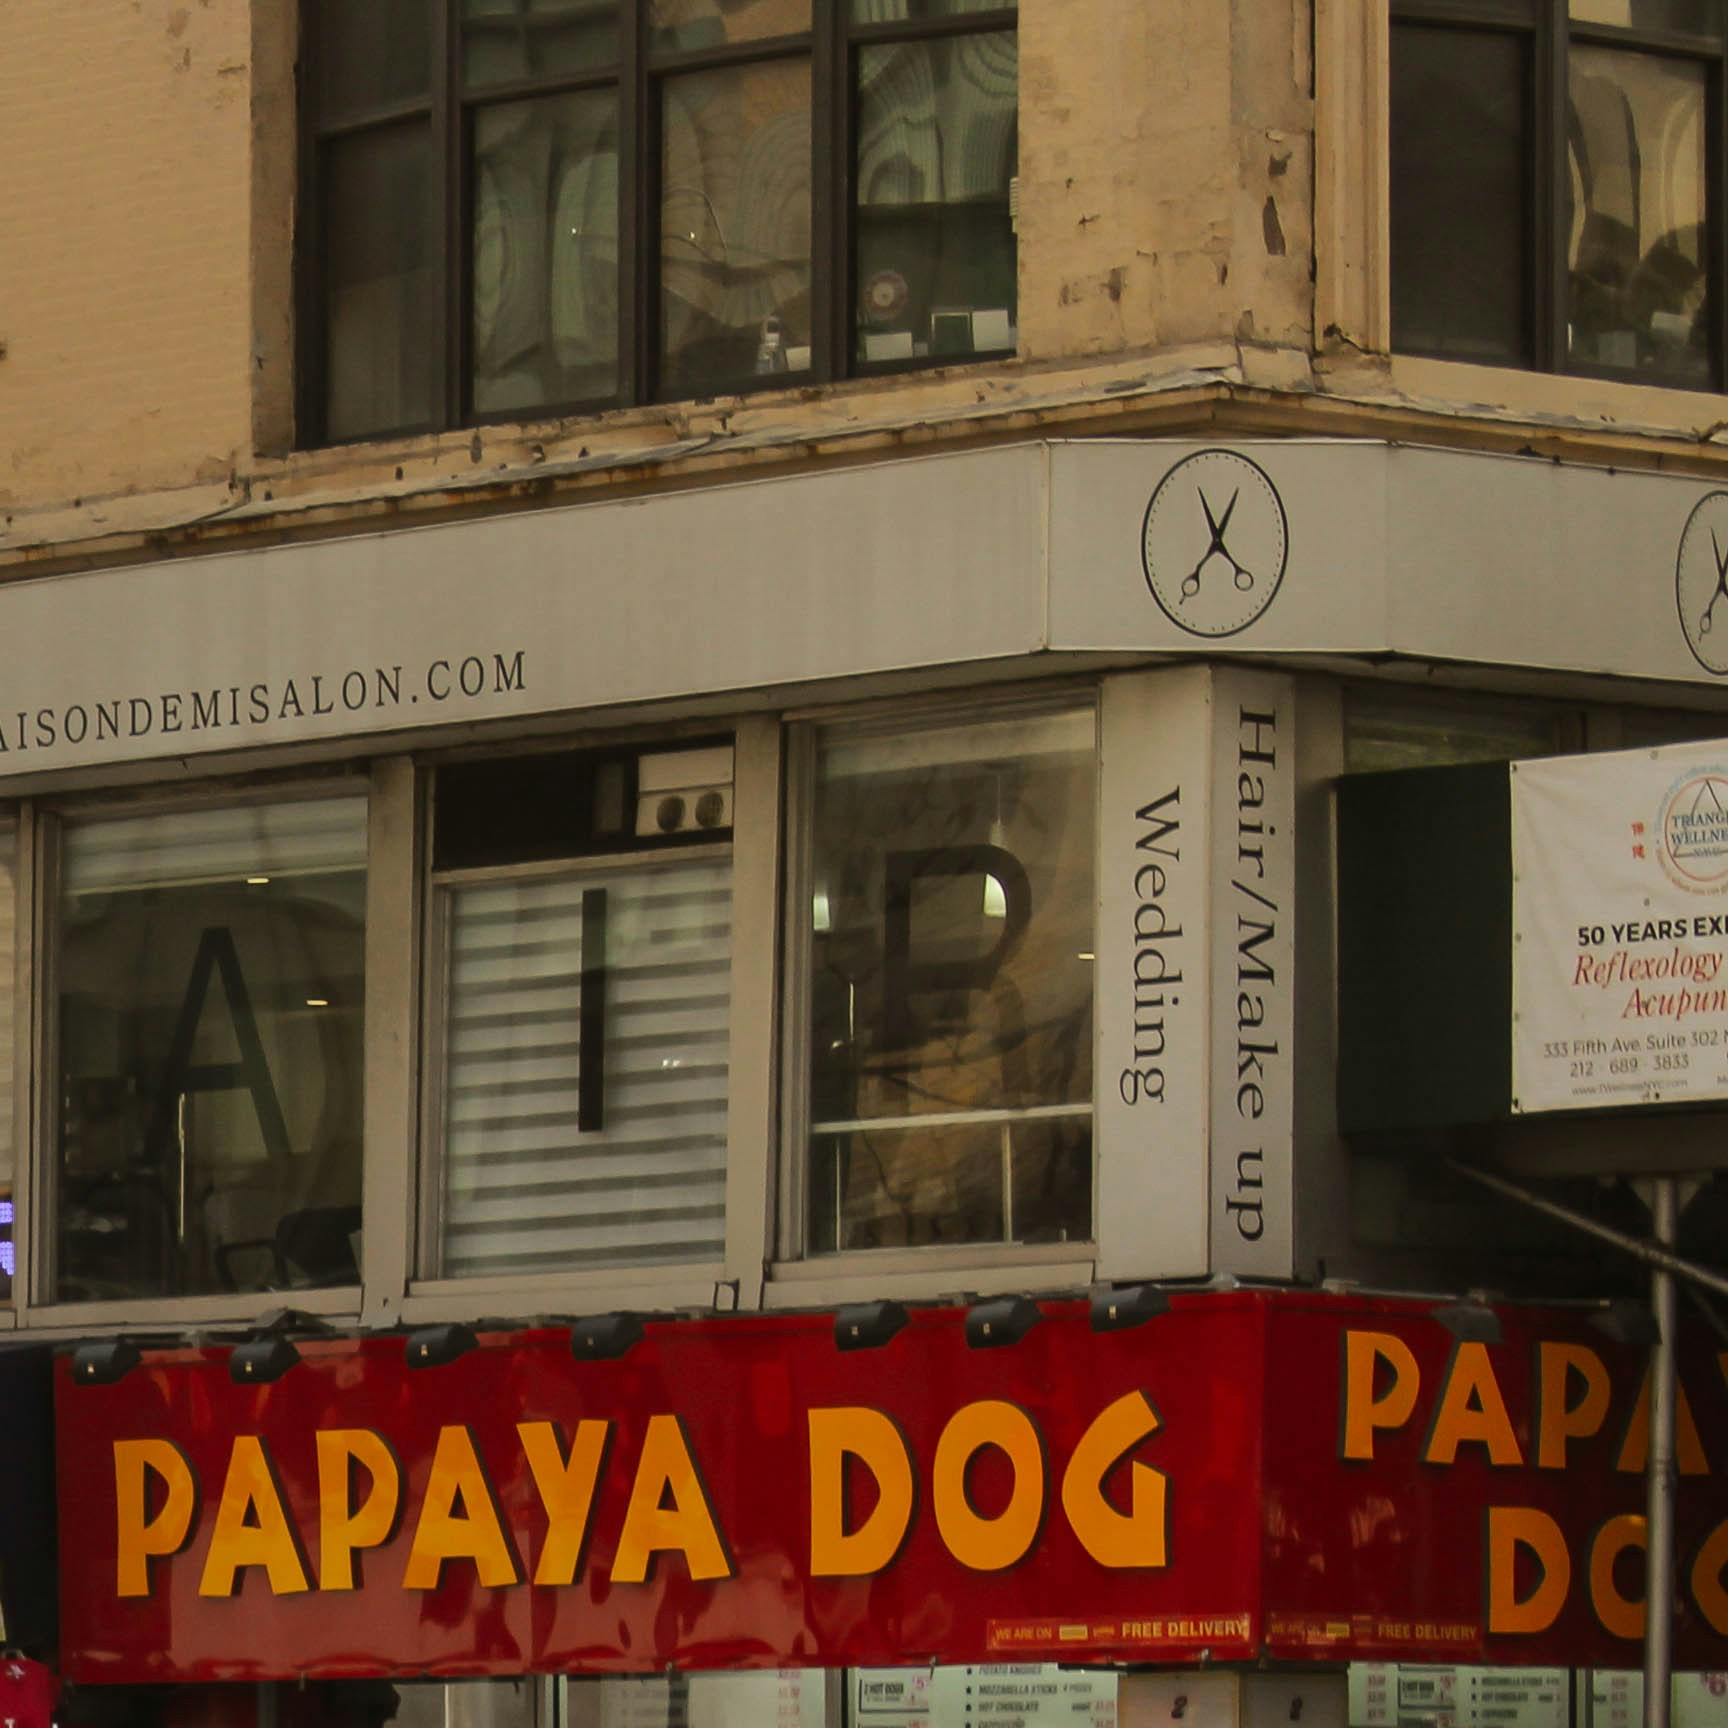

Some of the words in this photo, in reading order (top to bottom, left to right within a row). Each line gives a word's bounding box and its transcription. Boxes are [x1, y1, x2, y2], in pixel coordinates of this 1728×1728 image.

[1119, 785, 1183, 1105] Wedding
[1578, 926, 1605, 947] 50
[1612, 918, 1687, 944] YEARS
[1572, 947, 1724, 990] Reflexology
[150, 927, 292, 1165] A
[1544, 1041, 1569, 1059] 333
[1573, 1038, 1607, 1057] Fifth
[1646, 1033, 1686, 1051] Suite
[1691, 1030, 1719, 1048] 302
[1570, 1060, 1594, 1079] 212
[1609, 1057, 1639, 1075] 689
[1653, 1053, 1690, 1072] 3833
[1226, 1145, 1266, 1243] up
[1342, 1329, 1728, 1476] PAPA
[113, 1414, 736, 1598] PAPAYA
[807, 1388, 1174, 1577] DOG
[995, 1627, 1011, 1641] WE
[1013, 1627, 1034, 1641] ARE
[1035, 1627, 1053, 1641] ON
[1122, 1620, 1163, 1638] FREE
[1167, 1619, 1246, 1637] DELIVERY
[1378, 1623, 1412, 1639] FREE
[1415, 1624, 1478, 1641] DELIVERY
[1171, 1695, 1188, 1719] 2
